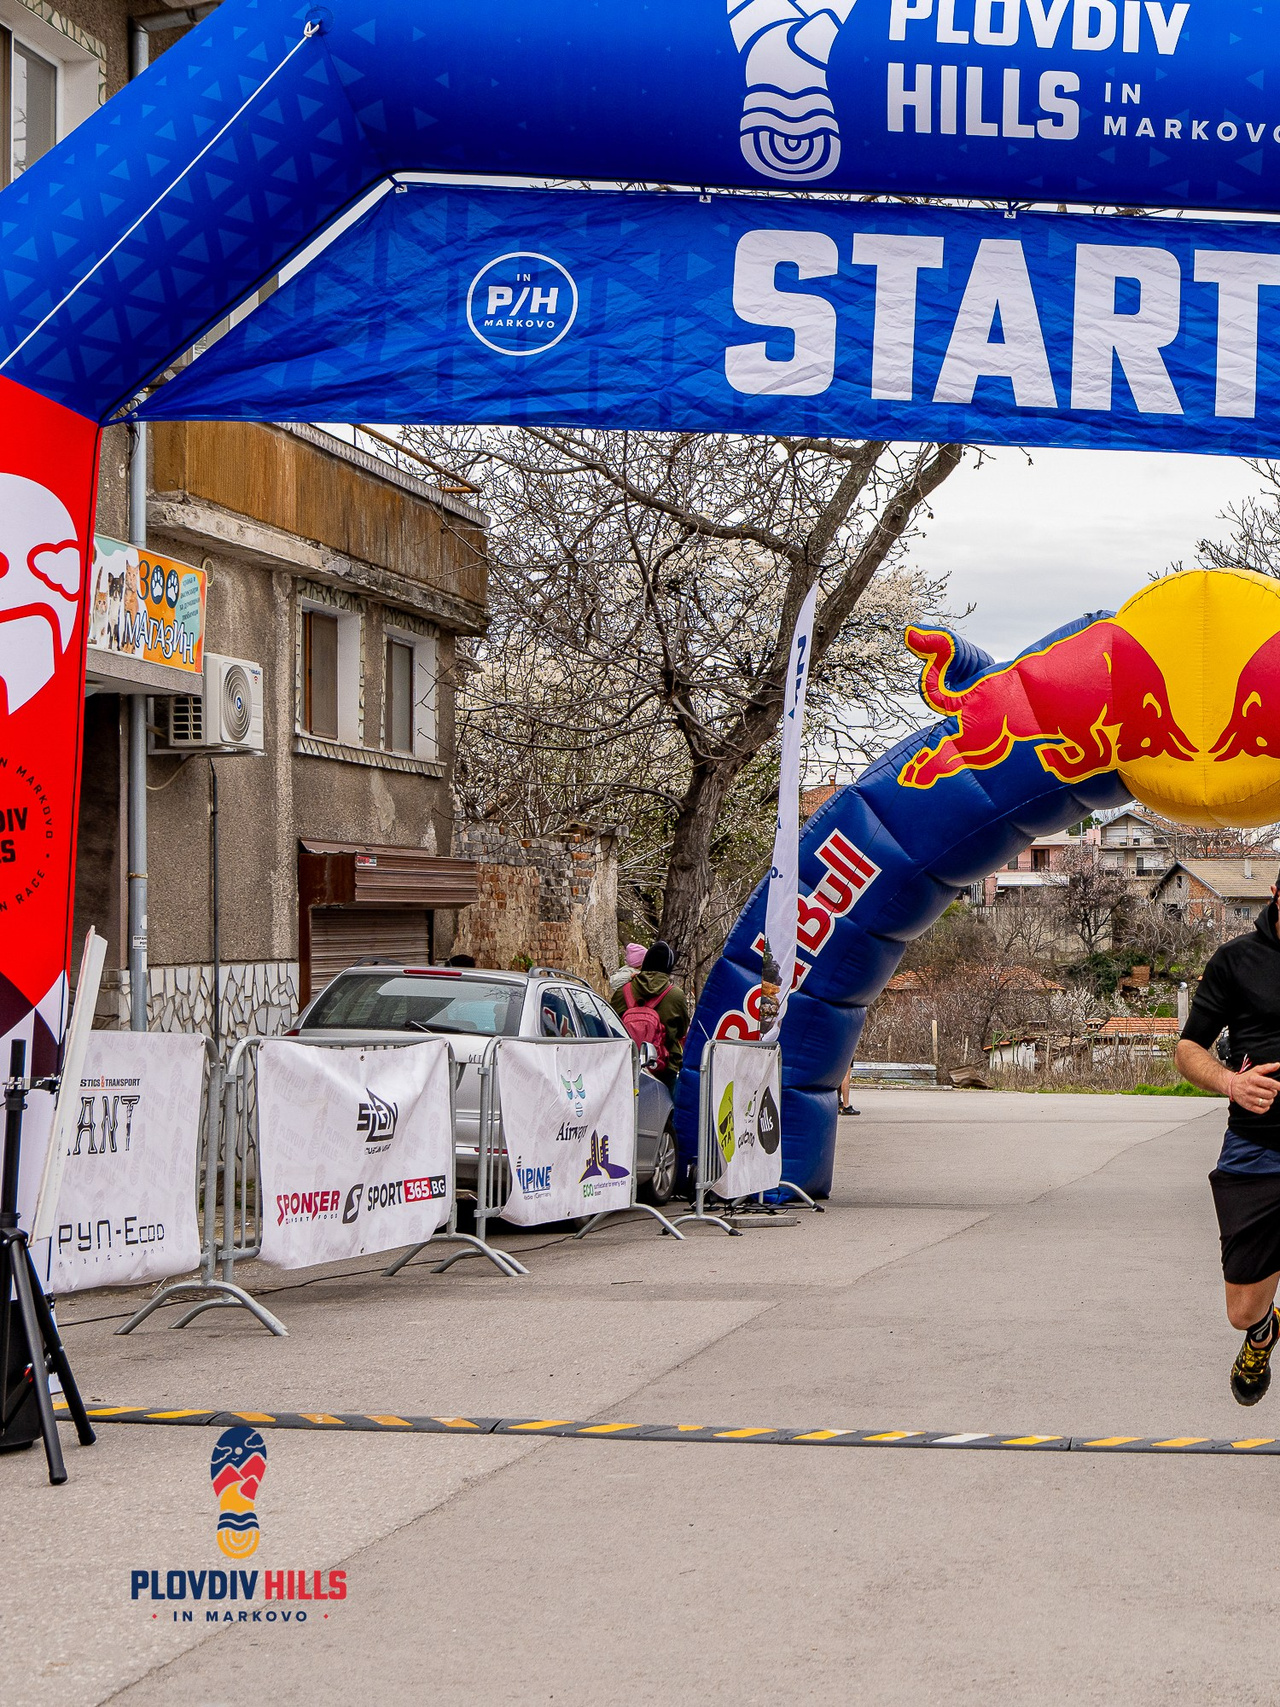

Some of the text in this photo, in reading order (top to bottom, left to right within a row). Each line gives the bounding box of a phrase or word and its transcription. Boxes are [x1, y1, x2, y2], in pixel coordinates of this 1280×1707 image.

[888, 0, 1191, 55] PLOVDIV
[887, 62, 1142, 141] HILLS IN
[516, 273, 532, 282] IN
[484, 318, 556, 330] MARKOVO
[487, 285, 559, 318] P/H
[123, 610, 194, 664] МАГАЗИН
[16, 765, 53, 839] MARKOVO
[15, 869, 45, 904] RACE
[797, 828, 882, 957] Bull
[68, 1094, 141, 1156] ANT
[276, 1190, 341, 1227] SPONSER
[583, 1183, 594, 1198] ECO
